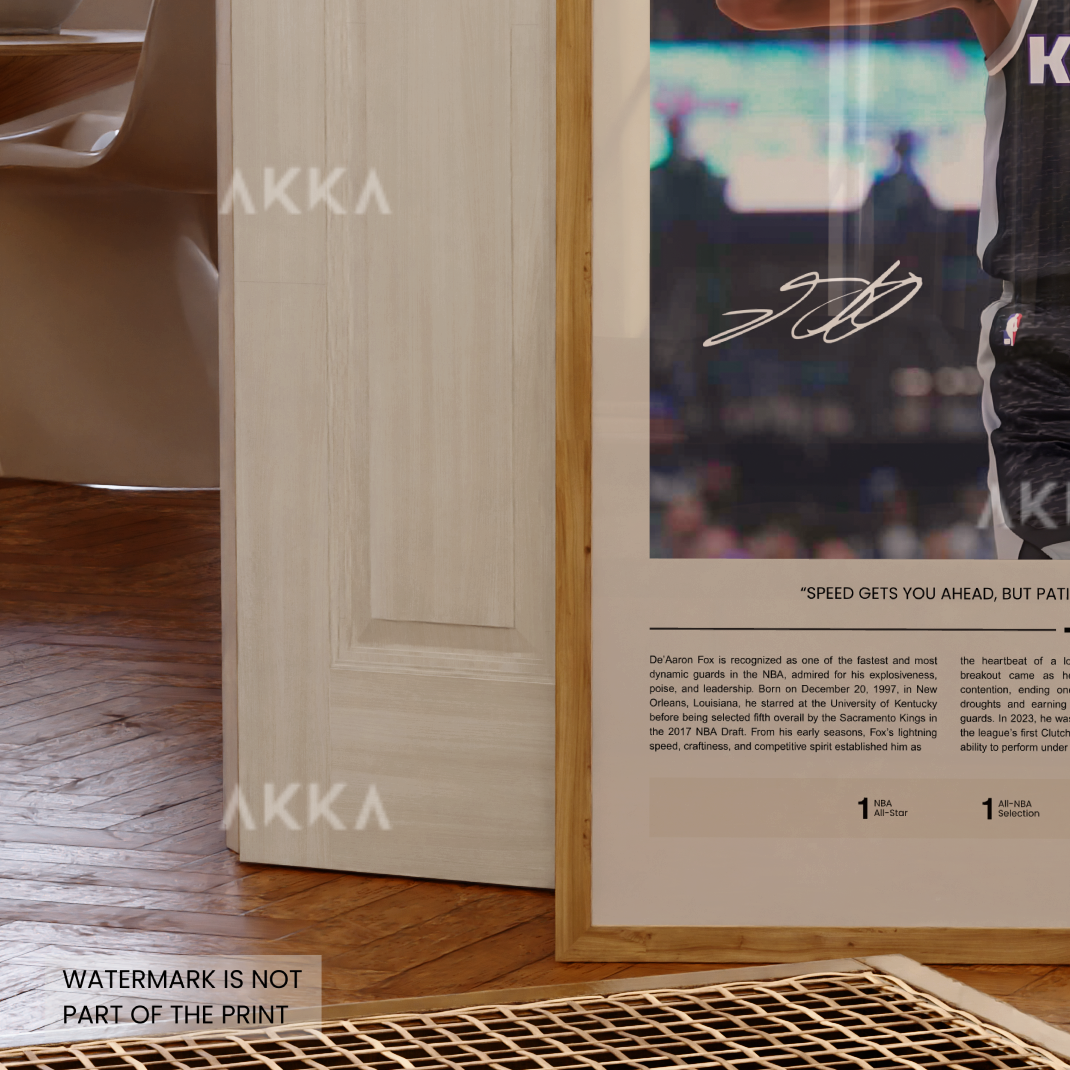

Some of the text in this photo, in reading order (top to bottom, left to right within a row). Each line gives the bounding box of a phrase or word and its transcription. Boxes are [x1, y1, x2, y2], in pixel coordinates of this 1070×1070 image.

[858, 586, 897, 599] GETS
[902, 586, 935, 600] YOU
[940, 587, 997, 602] AHEAD,
[1002, 587, 1031, 600] BUT
[697, 655, 714, 664] Fox
[718, 655, 726, 664] is
[730, 655, 781, 666] recognized
[823, 655, 833, 664] of
[837, 656, 852, 664] the
[857, 655, 888, 664] fastest
[892, 656, 910, 664] and
[914, 656, 937, 665] most
[649, 669, 937, 681] dynamic guards in the NBA, admired for his explosiveness,
[649, 684, 676, 694] poise,
[681, 684, 698, 693] and
[703, 683, 753, 694] leadership.
[758, 684, 780, 693] Born
[801, 684, 850, 693] December
[854, 684, 868, 694] 20,
[873, 684, 899, 694] 1997,
[903, 684, 911, 693] in
[916, 684, 937, 693] New
[649, 698, 937, 710] Orleans, Louisiana, he starred at the University of Kentucky
[649, 712, 937, 724] before being selected fifth overall by the Sacramento Kings in
[649, 727, 664, 735] the
[668, 727, 691, 735] 2017
[695, 726, 717, 736] NBA
[721, 727, 746, 736] Draft.
[751, 727, 774, 736] From
[779, 727, 792, 736] his
[796, 727, 819, 738] early
[823, 729, 865, 737] seasons,
[898, 727, 937, 739] lightning
[857, 797, 868, 819] 1
[874, 799, 892, 807] NBA
[982, 797, 992, 820] 1
[998, 799, 1032, 807] All-NBA
[873, 808, 908, 816] All-Star
[998, 809, 1040, 817] Selection
